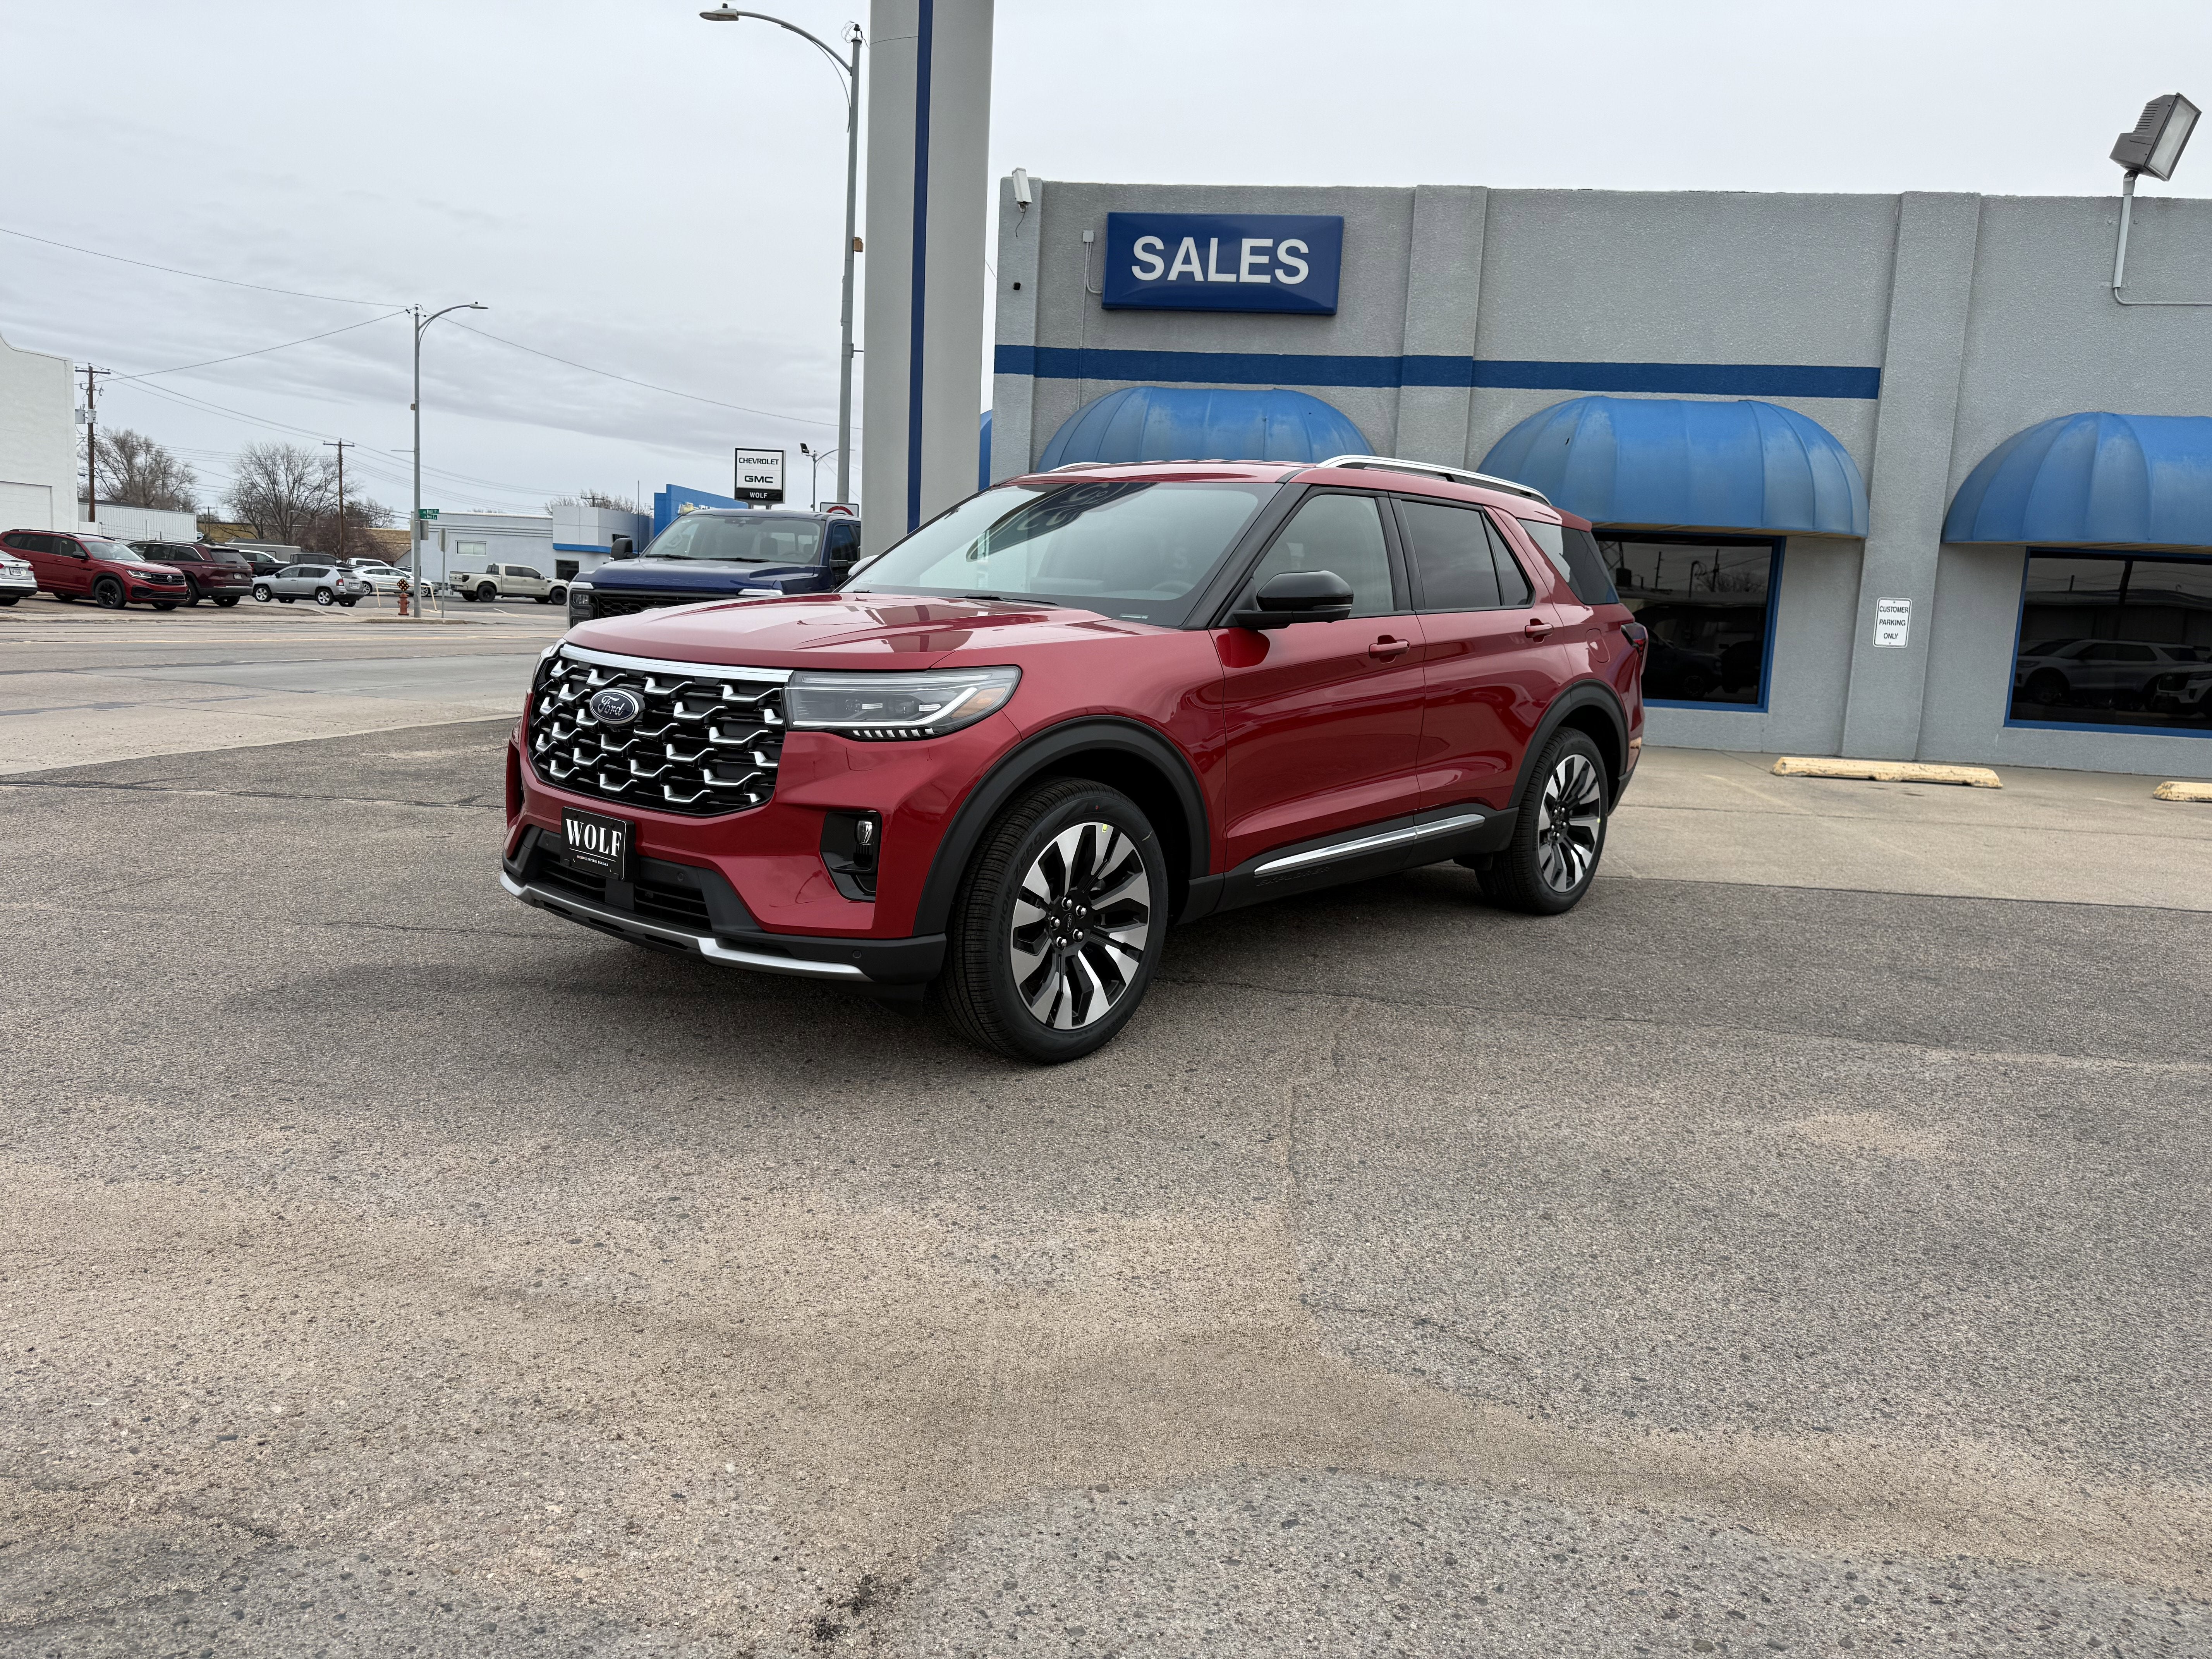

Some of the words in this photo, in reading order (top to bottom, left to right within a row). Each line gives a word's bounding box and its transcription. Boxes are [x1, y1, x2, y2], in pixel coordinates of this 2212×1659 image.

[1131, 235, 1309, 285] SALES
[744, 475, 773, 483] GMC
[598, 696, 625, 716] Ford
[565, 818, 622, 857] WOLF
[996, 884, 1013, 990] SCORPION
[1013, 830, 1043, 880] ZERO
